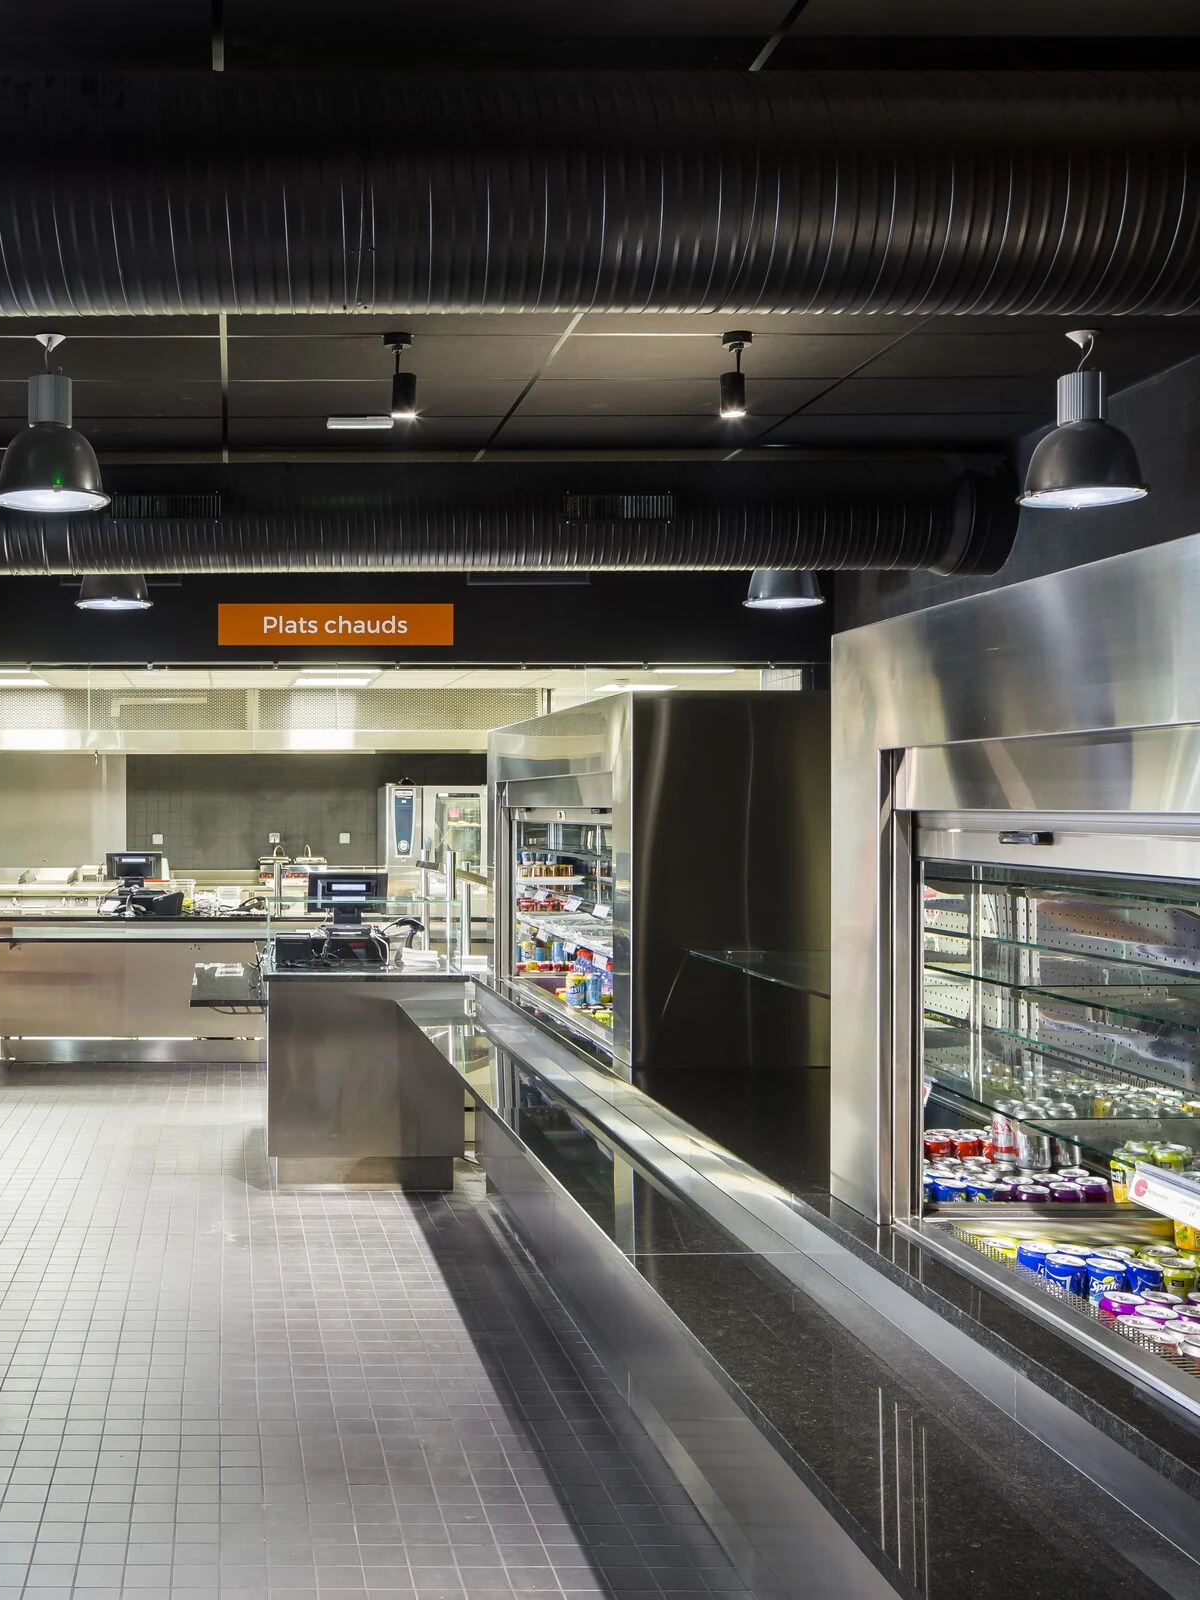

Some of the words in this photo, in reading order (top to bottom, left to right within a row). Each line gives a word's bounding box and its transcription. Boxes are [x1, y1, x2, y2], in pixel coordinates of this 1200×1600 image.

[263, 615, 318, 634] Plats
[324, 615, 408, 634] chauds
[1090, 1280, 1120, 1293] Sprite
